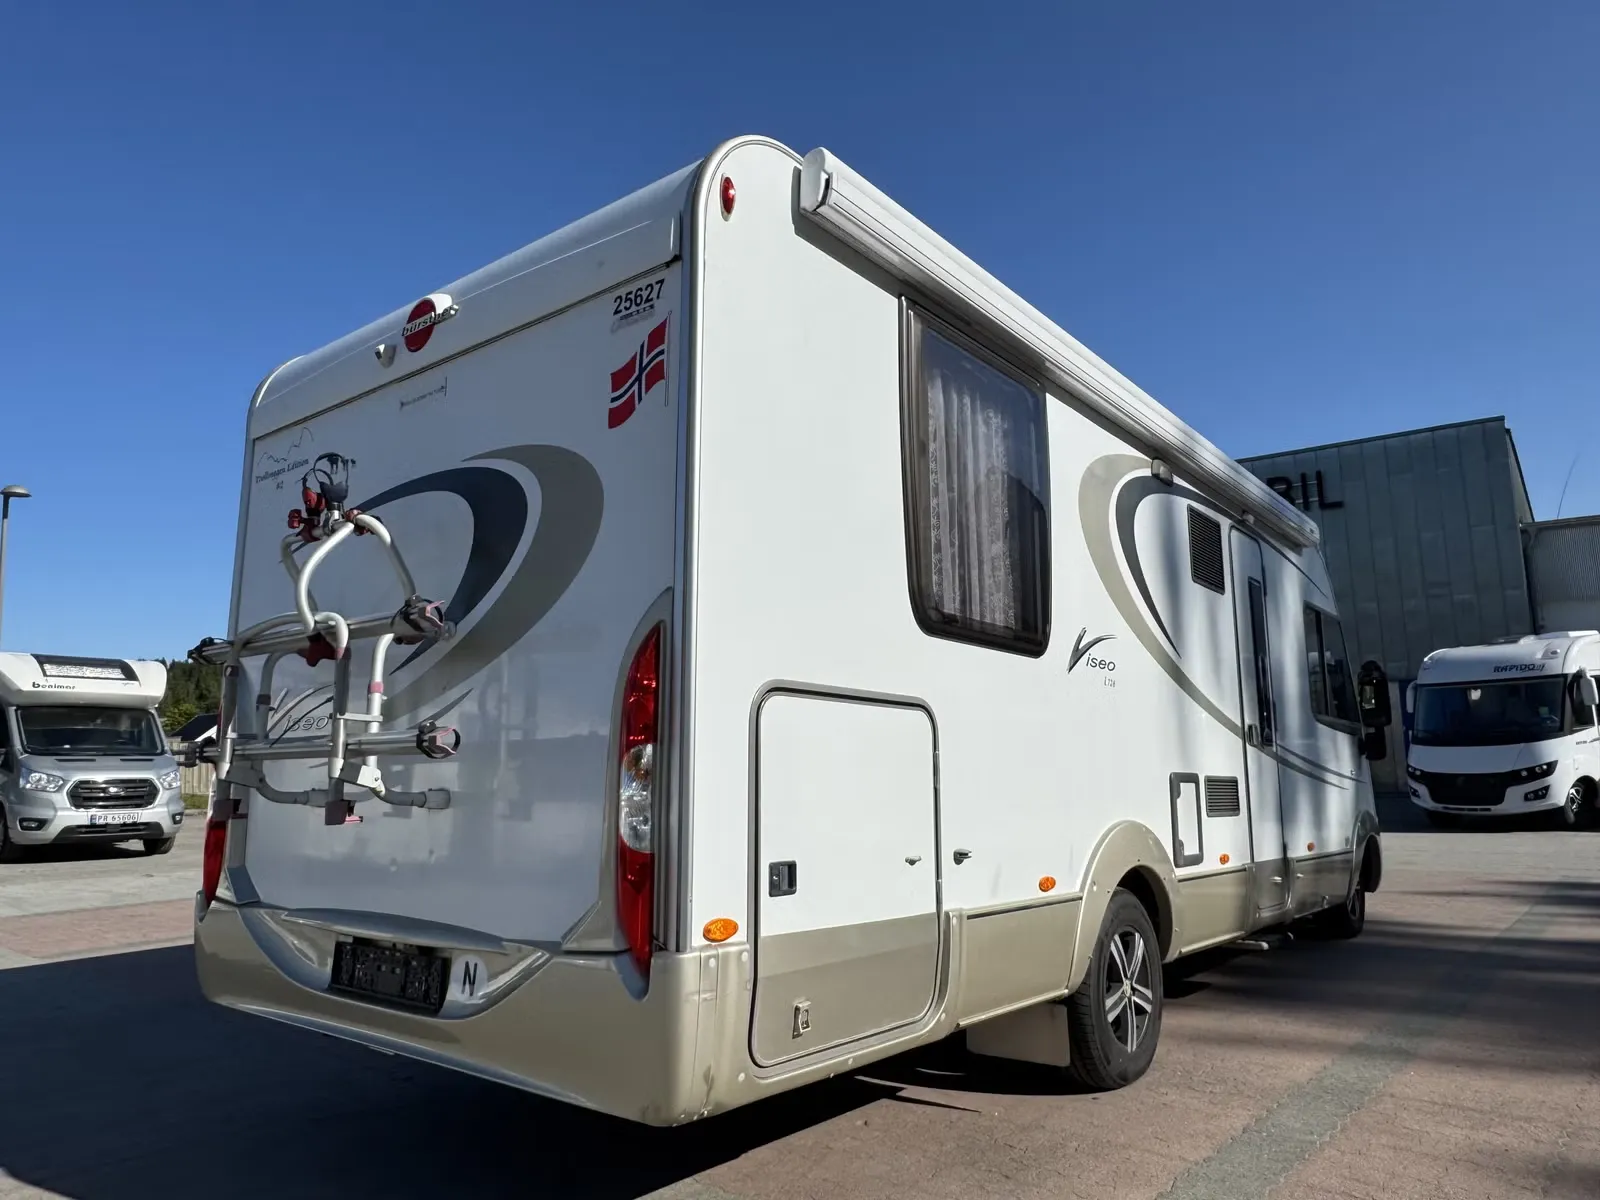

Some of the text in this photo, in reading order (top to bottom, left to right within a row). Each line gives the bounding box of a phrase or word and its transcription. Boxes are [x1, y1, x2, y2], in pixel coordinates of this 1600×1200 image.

[612, 278, 666, 316] 25627
[97, 815, 109, 823] PR
[460, 959, 479, 997] N
